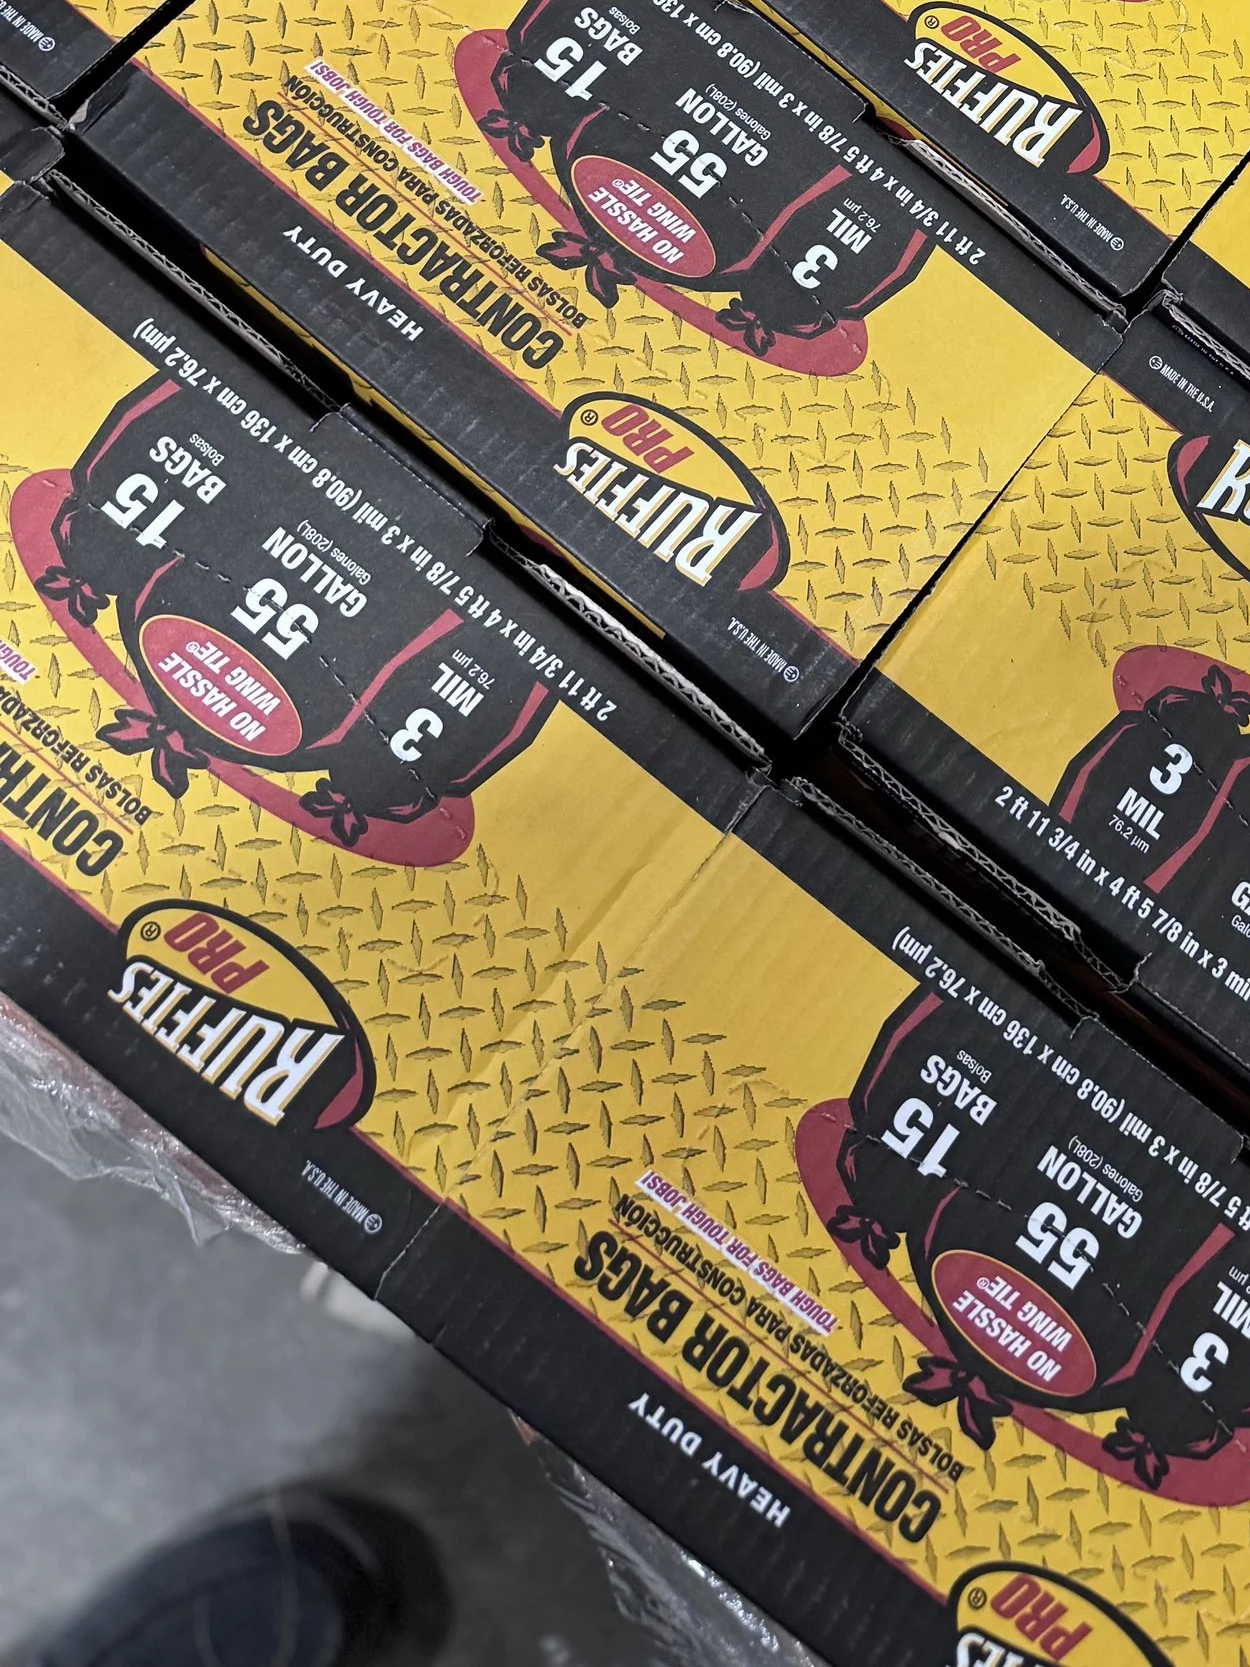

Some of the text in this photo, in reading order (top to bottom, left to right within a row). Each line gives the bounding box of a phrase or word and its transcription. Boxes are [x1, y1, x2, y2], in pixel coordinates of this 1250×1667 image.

[675, 87, 769, 167] GALLON
[901, 38, 1084, 169] RUFFIES
[650, 128, 728, 199] 55
[241, 99, 565, 370] CONTRACTOR BAGS
[281, 224, 424, 342] HEAVY DUTY
[551, 438, 761, 587] RUFFIES
[262, 526, 368, 617] GALLON
[231, 576, 320, 660] 55
[156, 653, 266, 743] NO HASSLE
[224, 668, 281, 717] WING
[431, 661, 485, 717] MIL
[391, 707, 444, 762] 3
[1108, 814, 1134, 840] 76.2
[994, 785, 1014, 807] 2
[1009, 796, 1029, 821] ft
[1026, 810, 1051, 837] 11
[1048, 827, 1080, 861] 3/4
[1075, 848, 1097, 876] in
[1093, 866, 1110, 887] x
[1108, 876, 1125, 897] 4
[1121, 885, 1141, 910] ft
[1137, 897, 1155, 919] 5
[1151, 908, 1183, 943] 7/8
[1179, 930, 1200, 959] in
[1197, 949, 1214, 969] x
[1211, 957, 1228, 979] 3
[104, 957, 345, 1128] RUFFIES
[956, 1050, 992, 1084] Bolsas
[920, 1055, 997, 1126] BAGS
[878, 1097, 961, 1178] 15
[573, 1229, 942, 1544] CONTRACTOR BAGS
[627, 1391, 790, 1527] HEAVY DUTY
